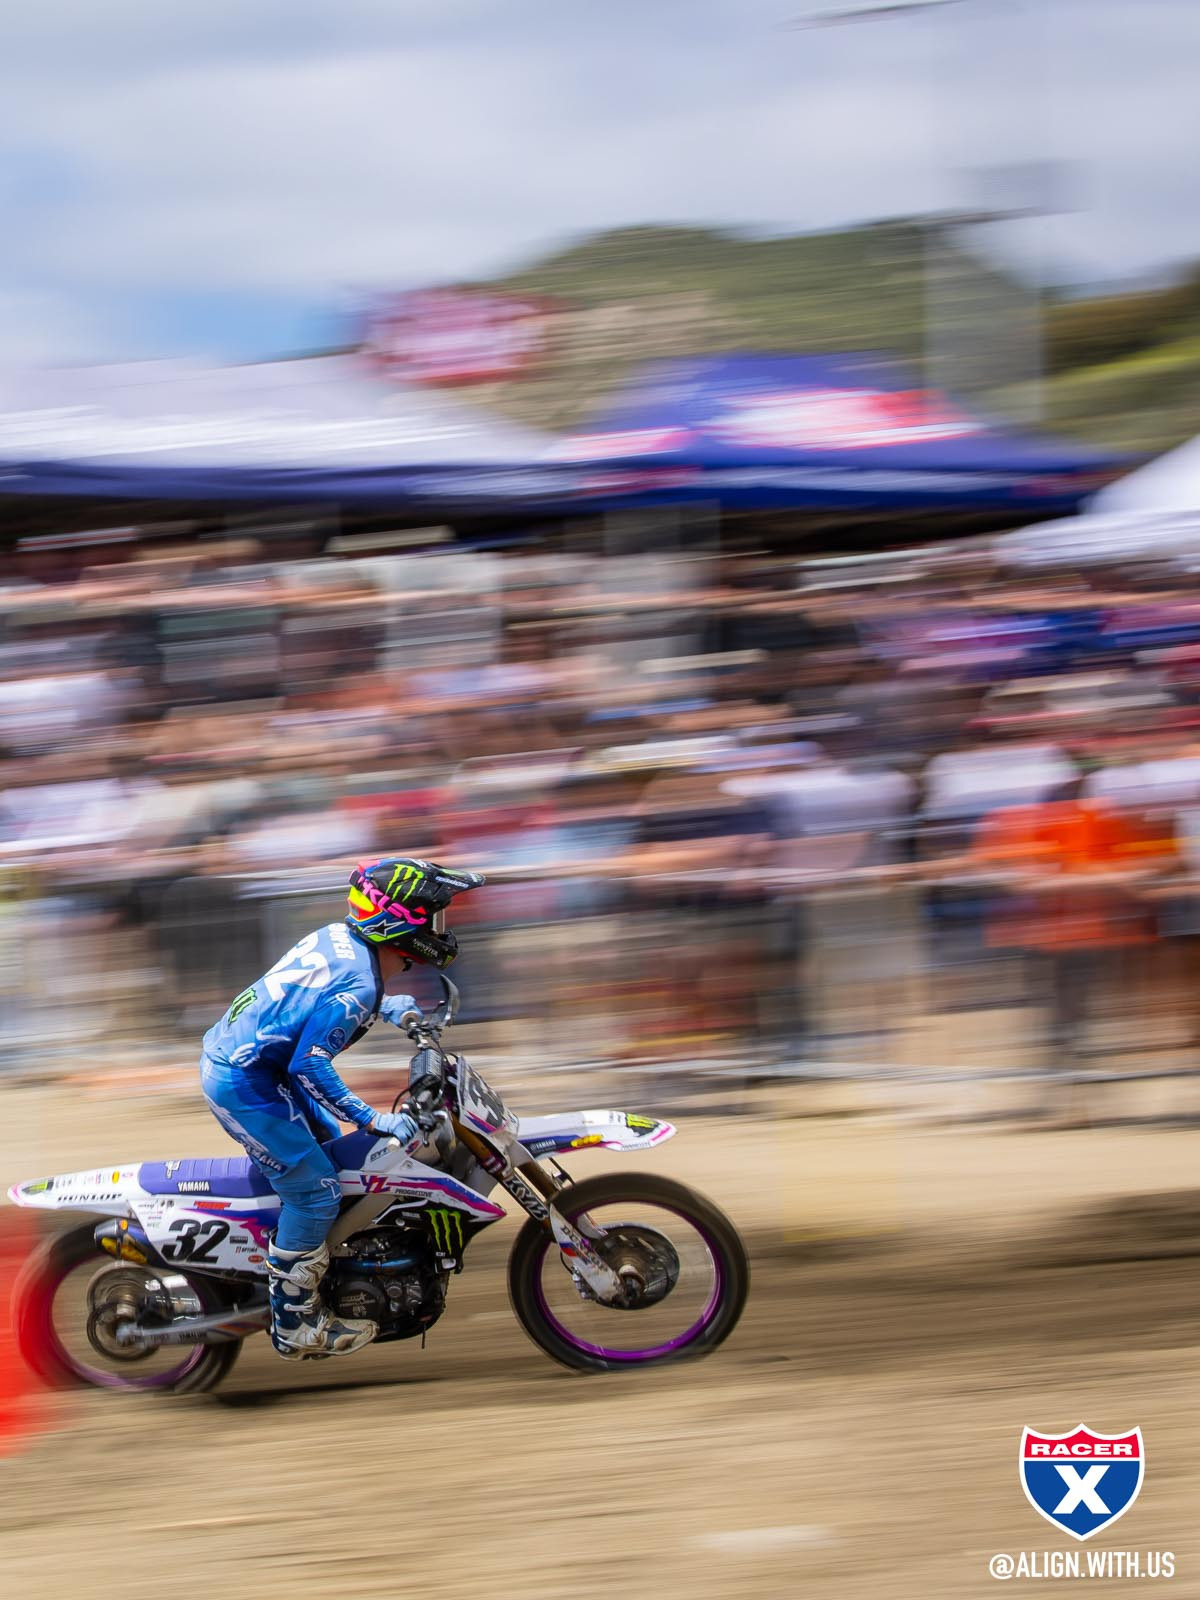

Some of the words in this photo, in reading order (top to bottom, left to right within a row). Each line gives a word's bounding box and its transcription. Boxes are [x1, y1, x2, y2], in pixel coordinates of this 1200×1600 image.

[263, 931, 331, 1002] 32
[57, 1193, 123, 1202] DUNLOP
[177, 1181, 210, 1192] YAMAHA
[161, 1219, 231, 1264] 32
